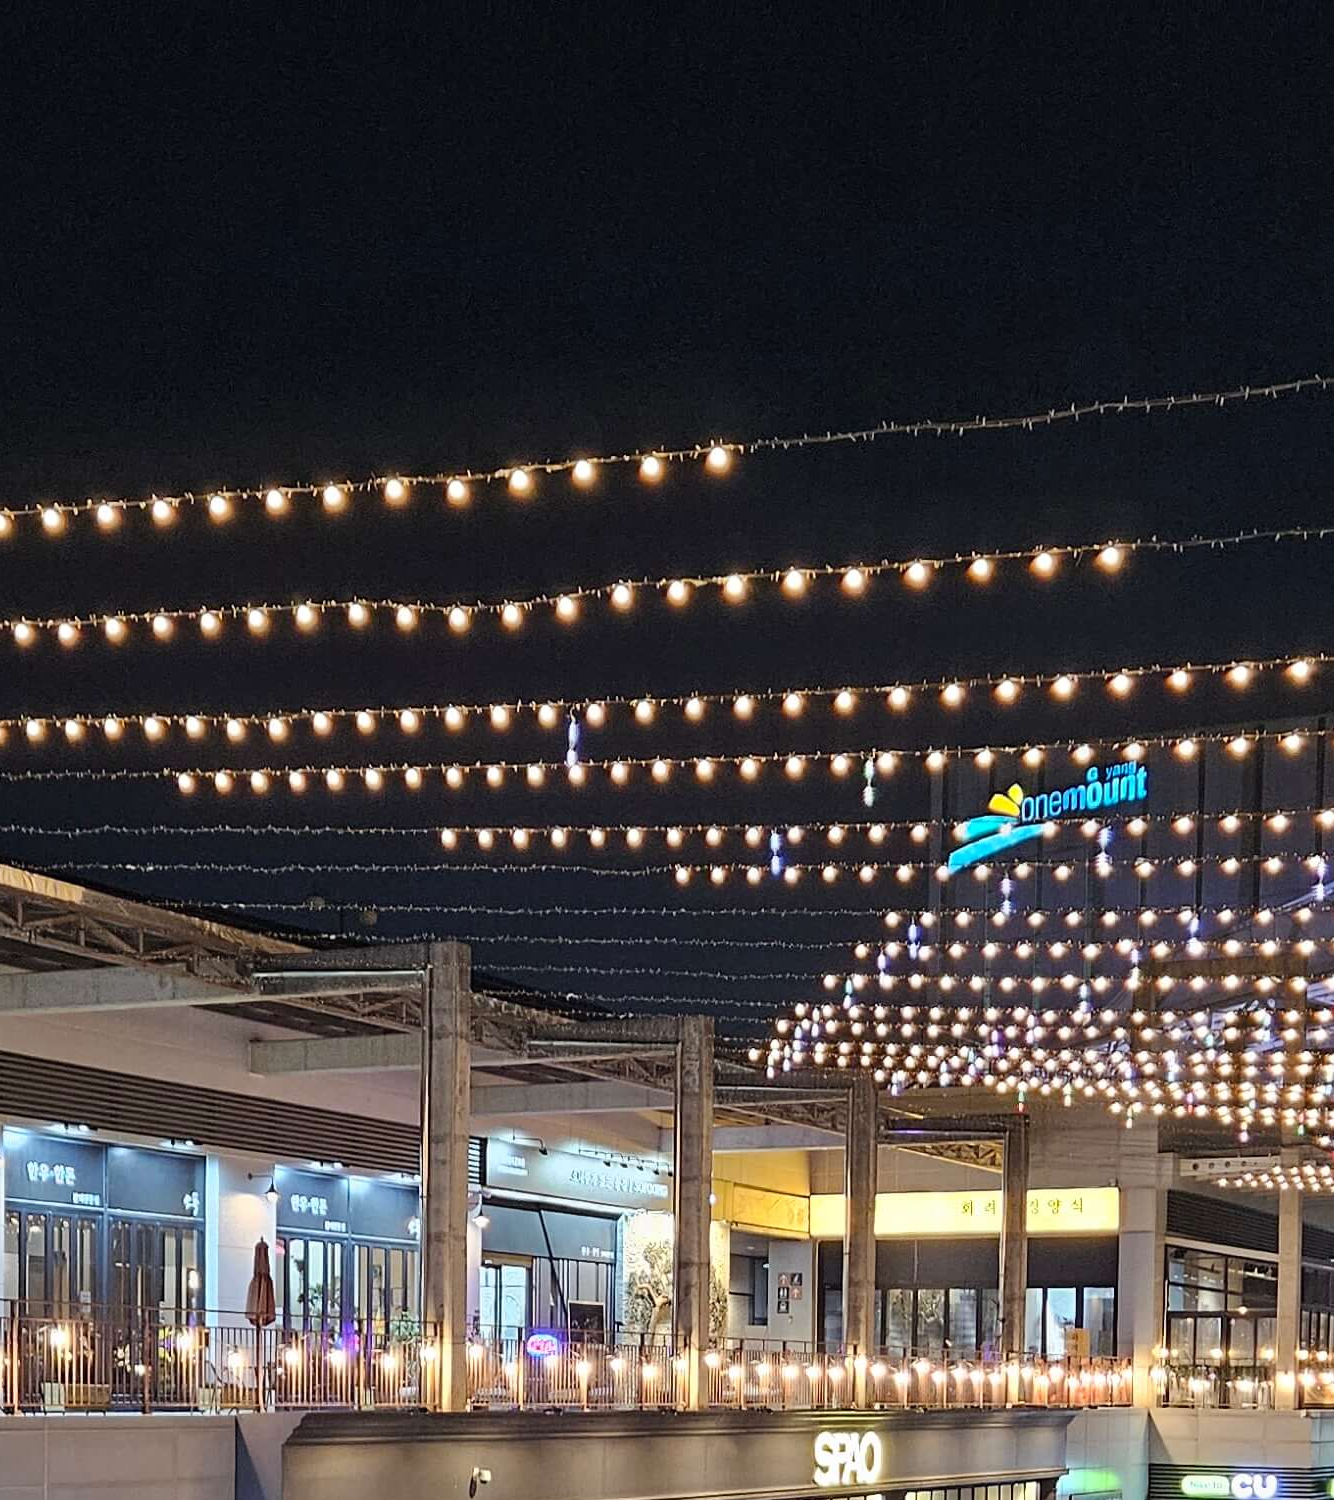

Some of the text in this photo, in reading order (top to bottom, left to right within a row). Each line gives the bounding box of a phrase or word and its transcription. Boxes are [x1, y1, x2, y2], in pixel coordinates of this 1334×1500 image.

[1021, 766, 1148, 822] onemount
[814, 1431, 881, 1486] SPAO
[1231, 1473, 1278, 1500] CU
